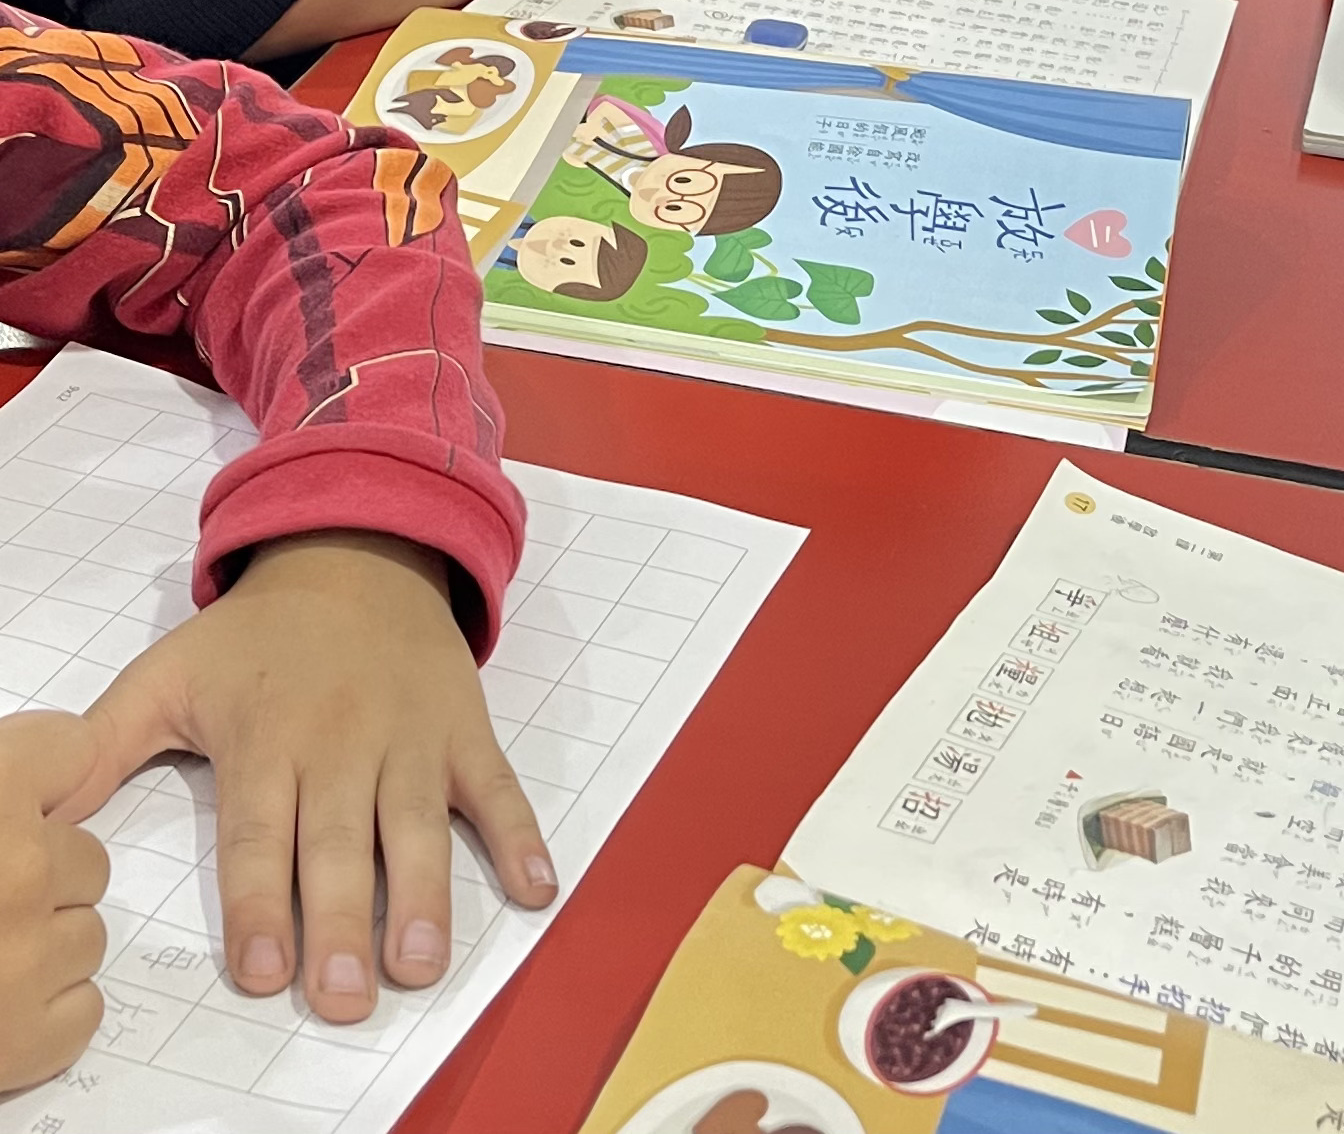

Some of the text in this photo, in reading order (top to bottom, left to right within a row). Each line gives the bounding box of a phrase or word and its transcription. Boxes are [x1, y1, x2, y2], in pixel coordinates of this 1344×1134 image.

[812, 175, 1112, 250] 二 放學後
[1075, 495, 1090, 511] 17
[901, 586, 1099, 823] 招 湯 拋 糧 姐 爭
